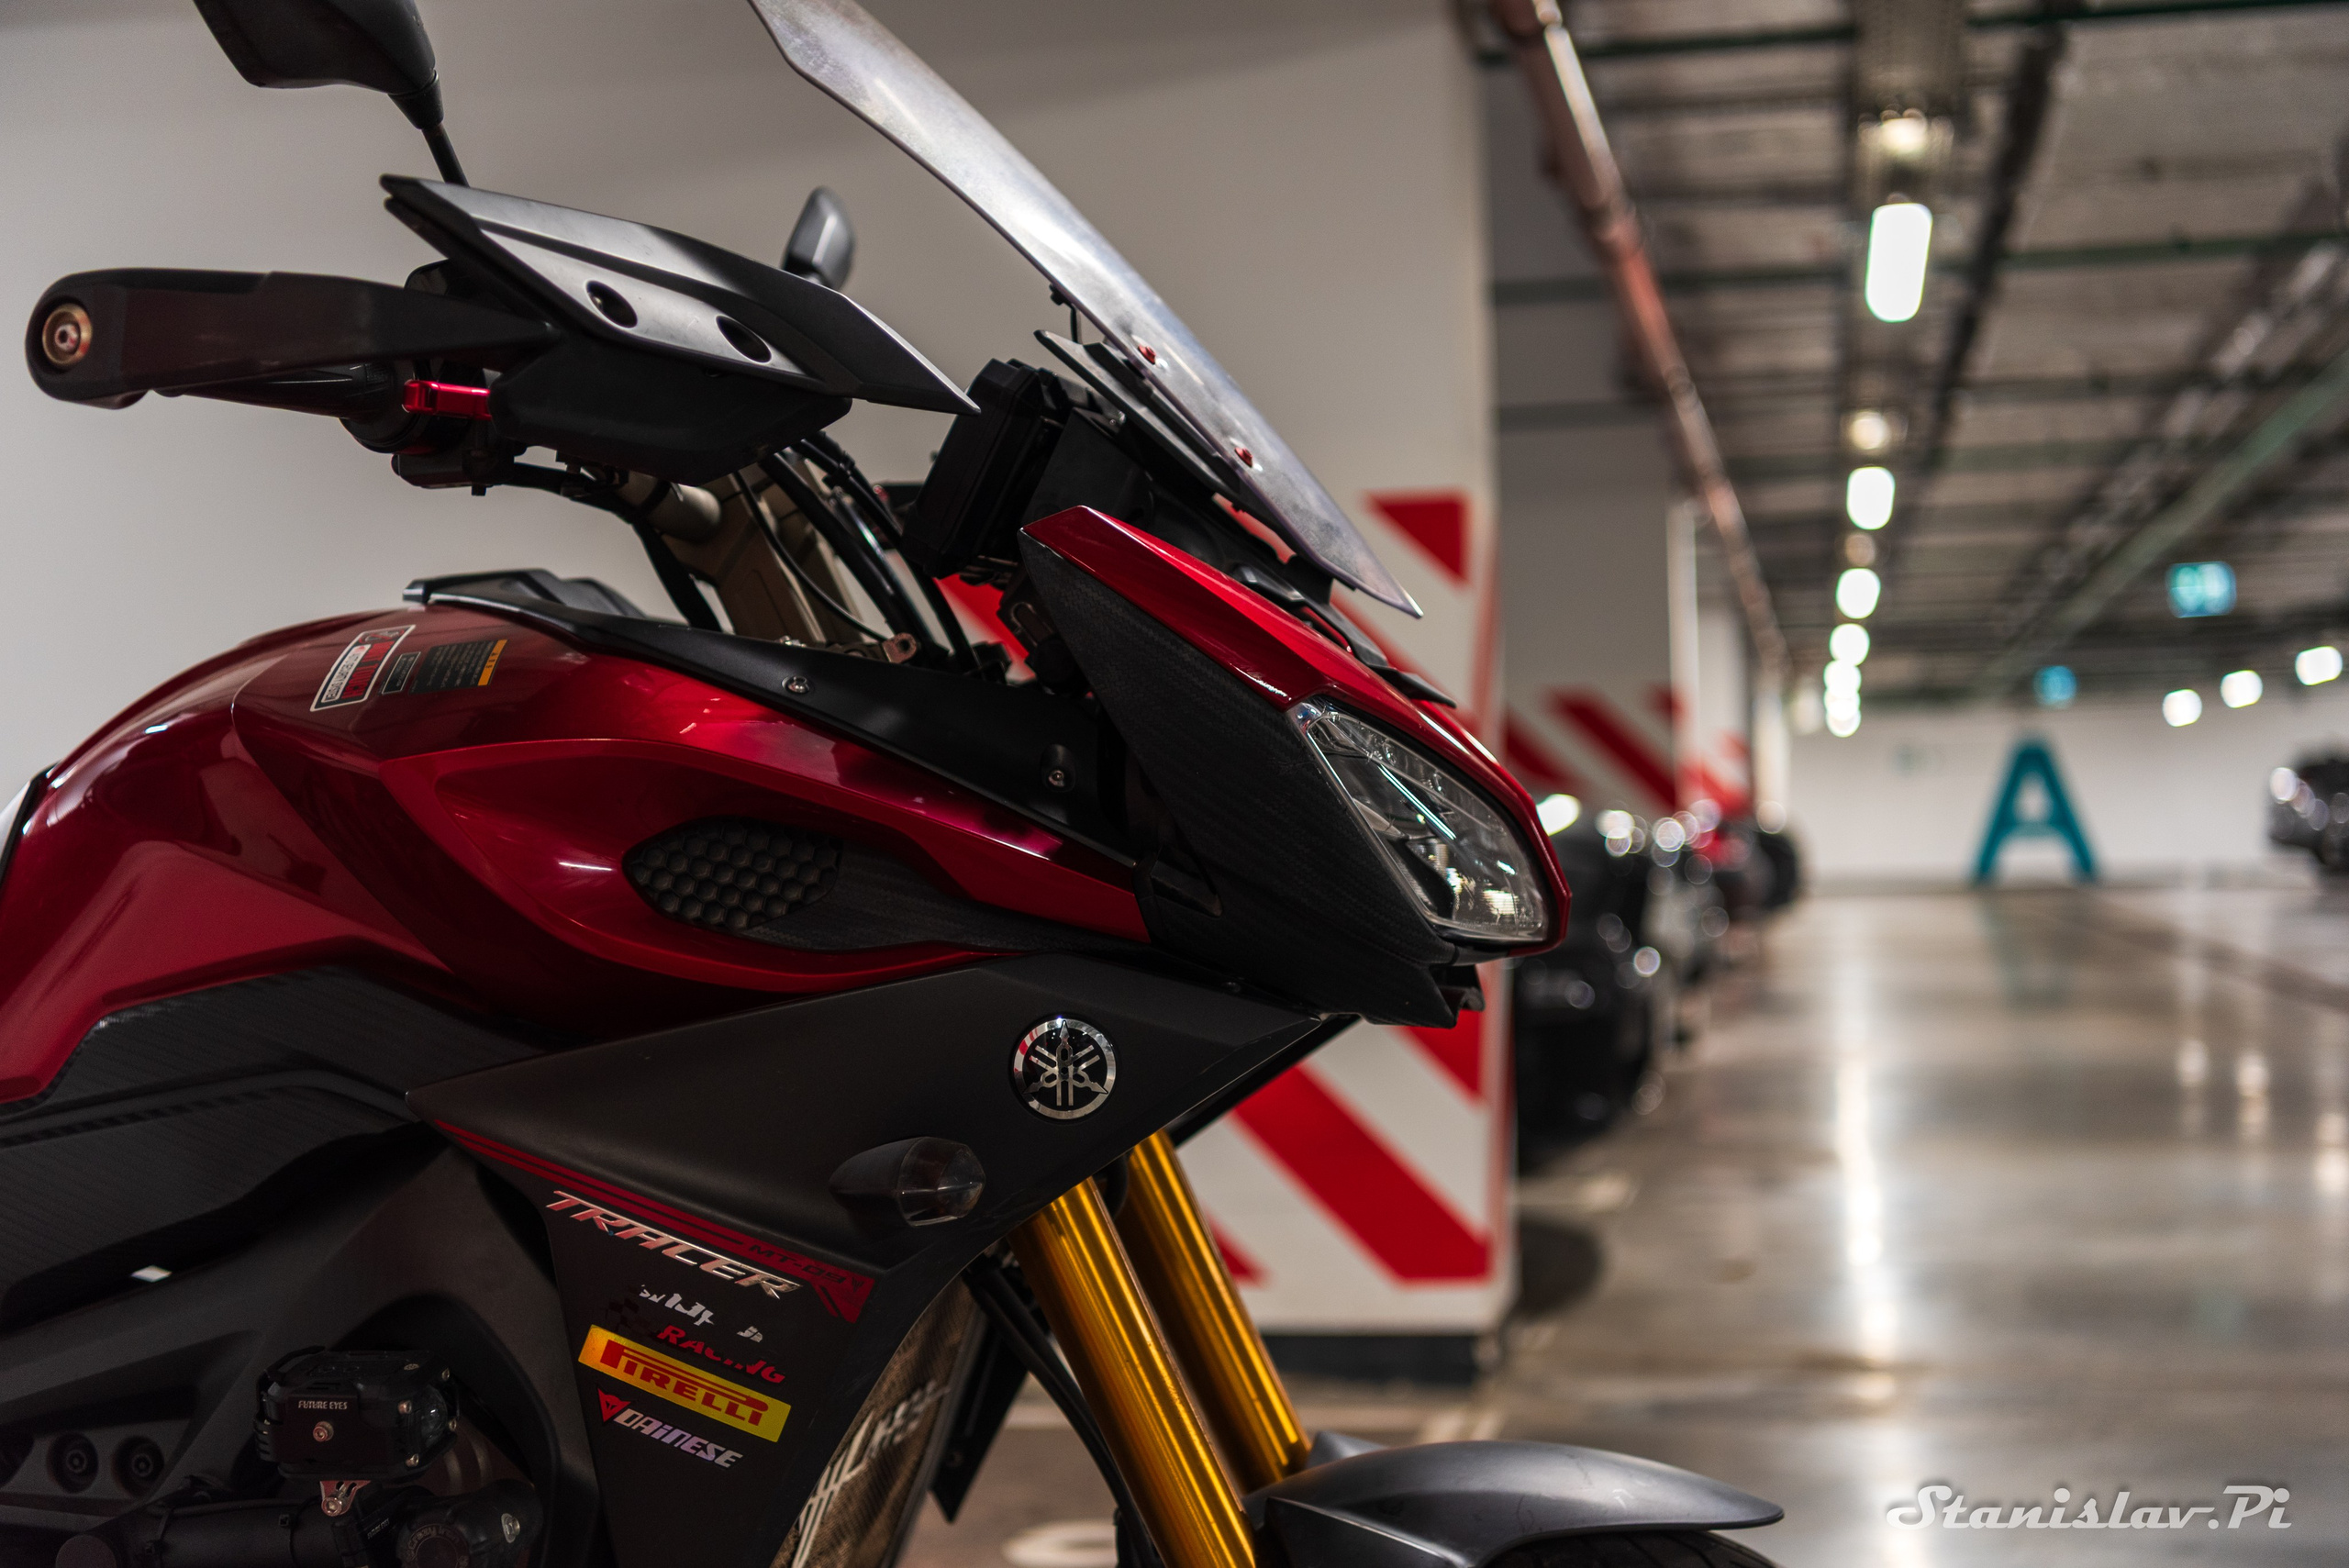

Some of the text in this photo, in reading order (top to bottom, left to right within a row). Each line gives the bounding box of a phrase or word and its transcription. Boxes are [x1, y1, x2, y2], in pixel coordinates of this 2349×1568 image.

[1970, 737, 2099, 883] A
[546, 1190, 803, 1299] TRACER
[748, 1244, 846, 1284] MT-09
[298, 1400, 348, 1410] FUTURE EYES
[600, 1339, 769, 1427] PIRELLI
[612, 1407, 744, 1468] DAINESE
